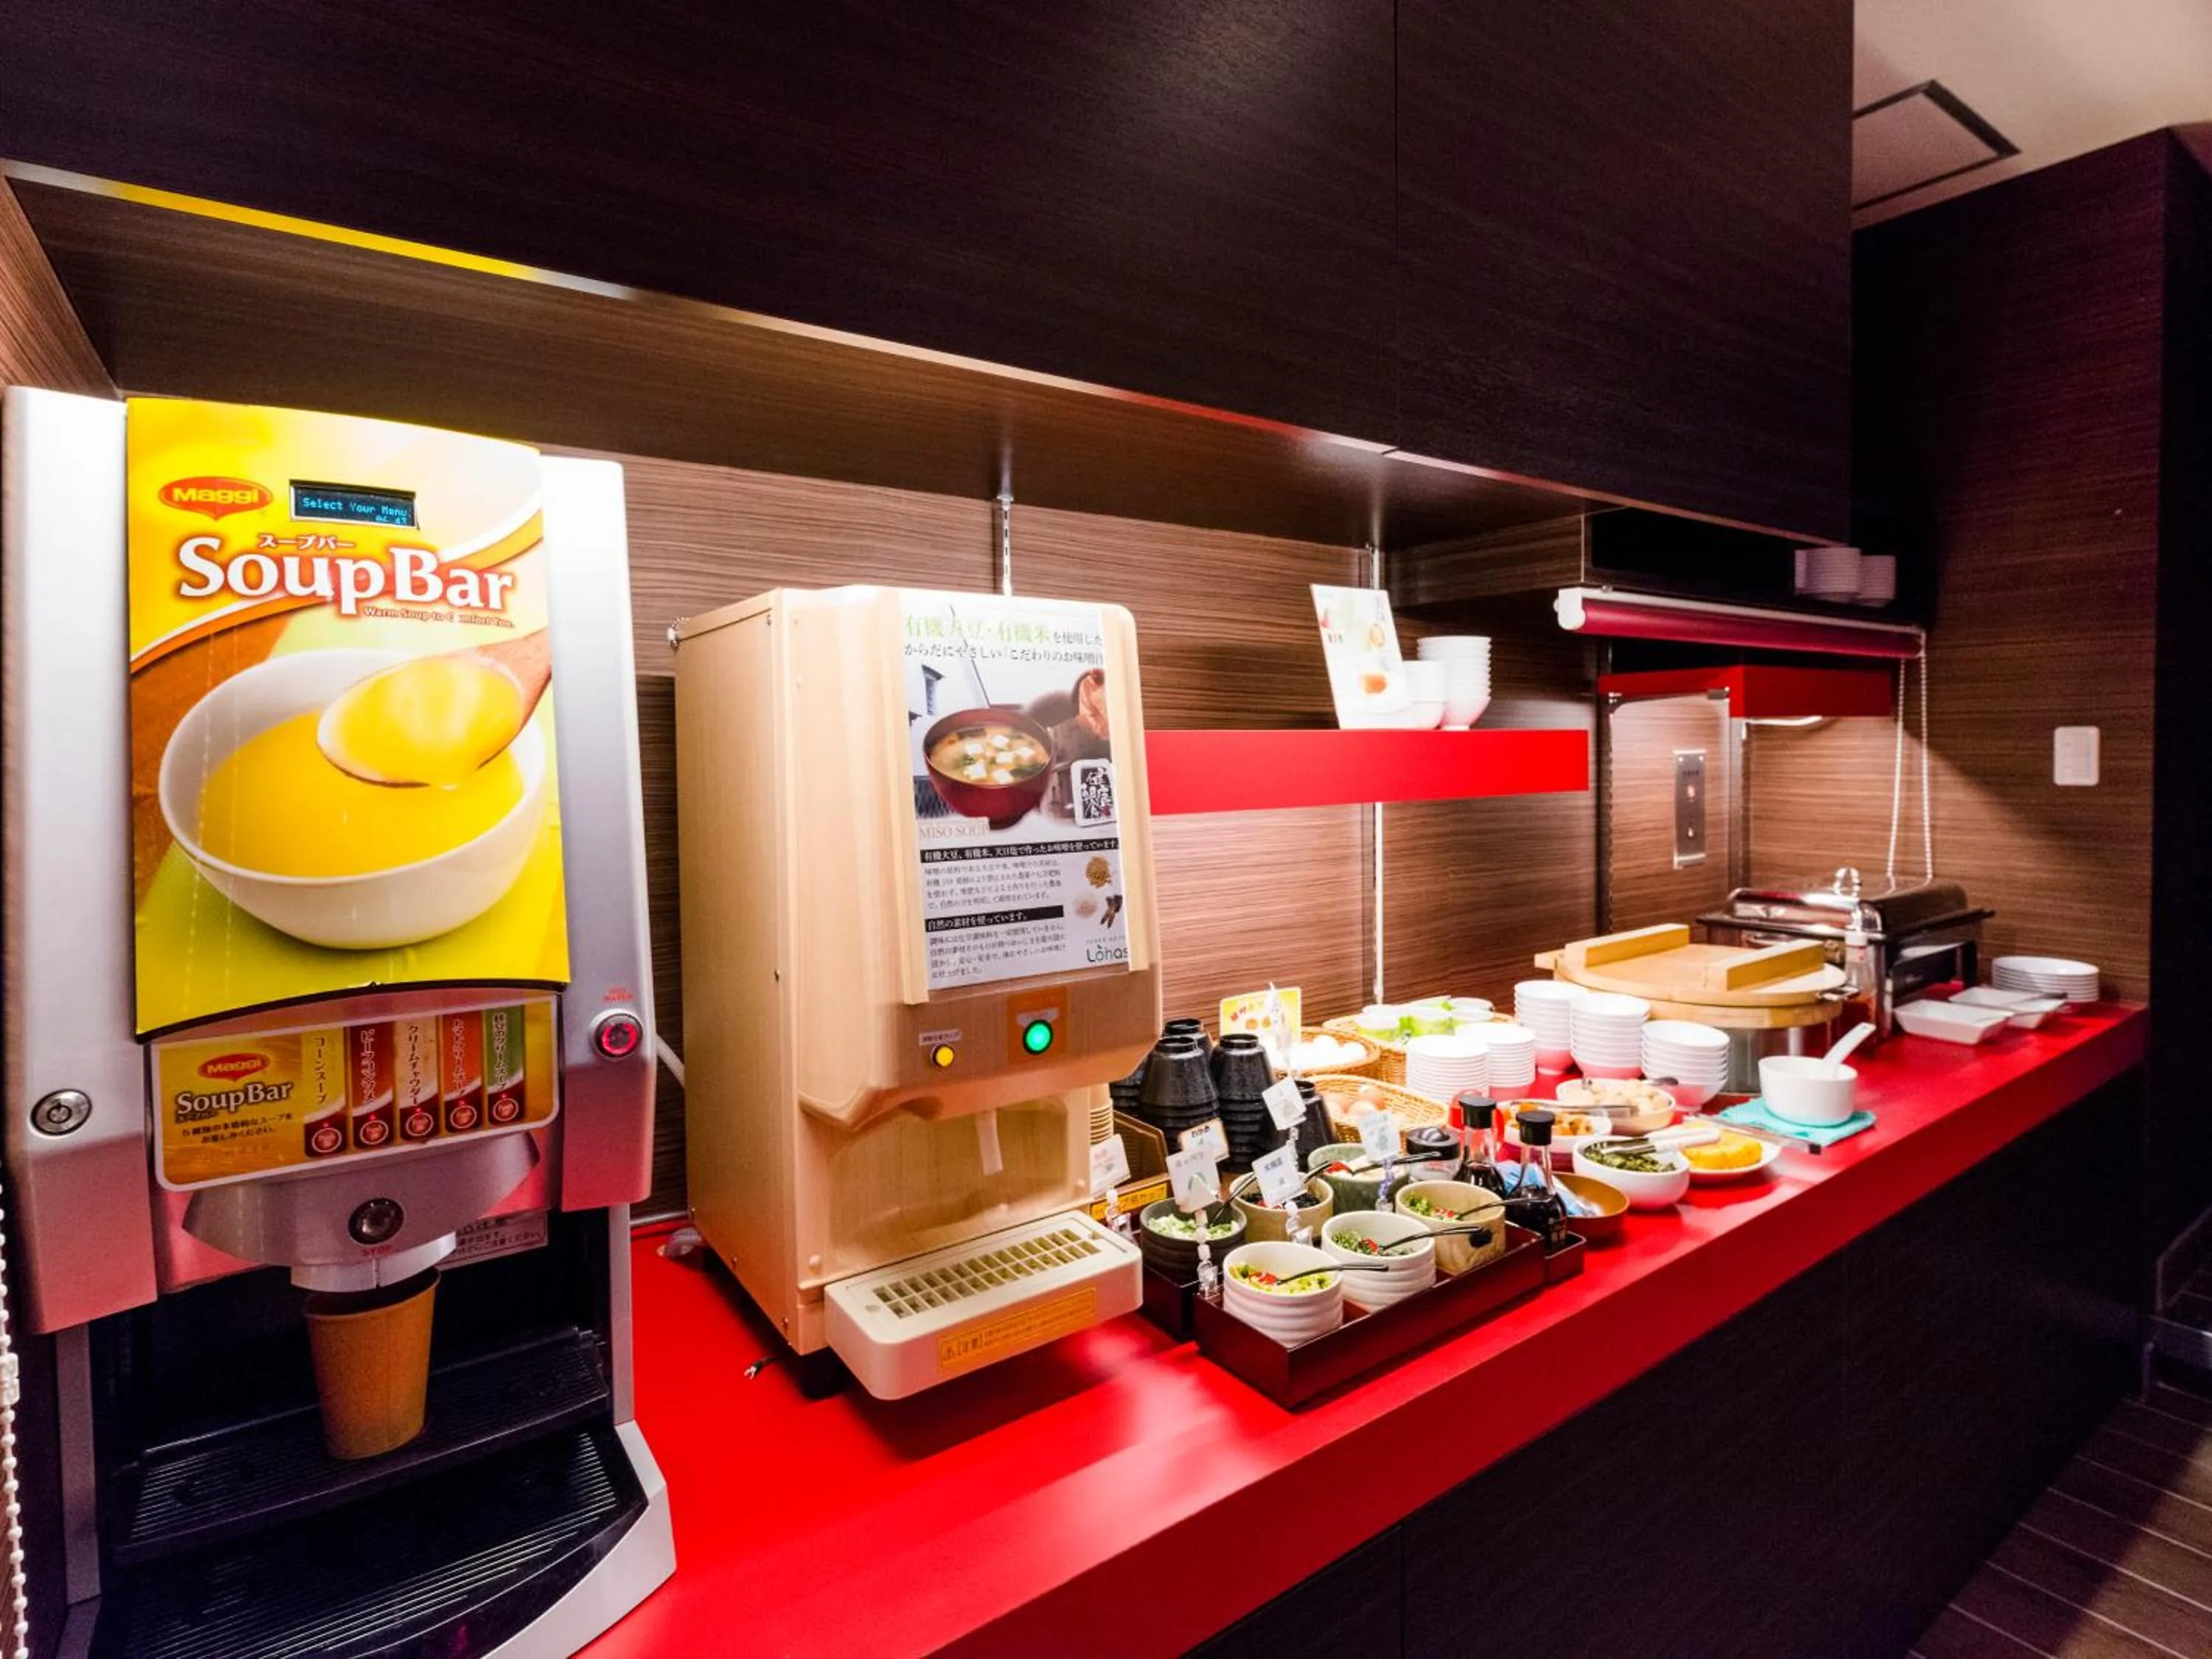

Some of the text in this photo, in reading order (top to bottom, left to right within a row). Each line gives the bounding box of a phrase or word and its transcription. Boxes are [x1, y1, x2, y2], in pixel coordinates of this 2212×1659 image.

[173, 487, 258, 504] Maggi
[302, 497, 343, 510] Select
[349, 501, 377, 514] Your
[258, 534, 355, 549] スープバー
[364, 606, 399, 618] Warm
[314, 1036, 327, 1105] コーンスープ
